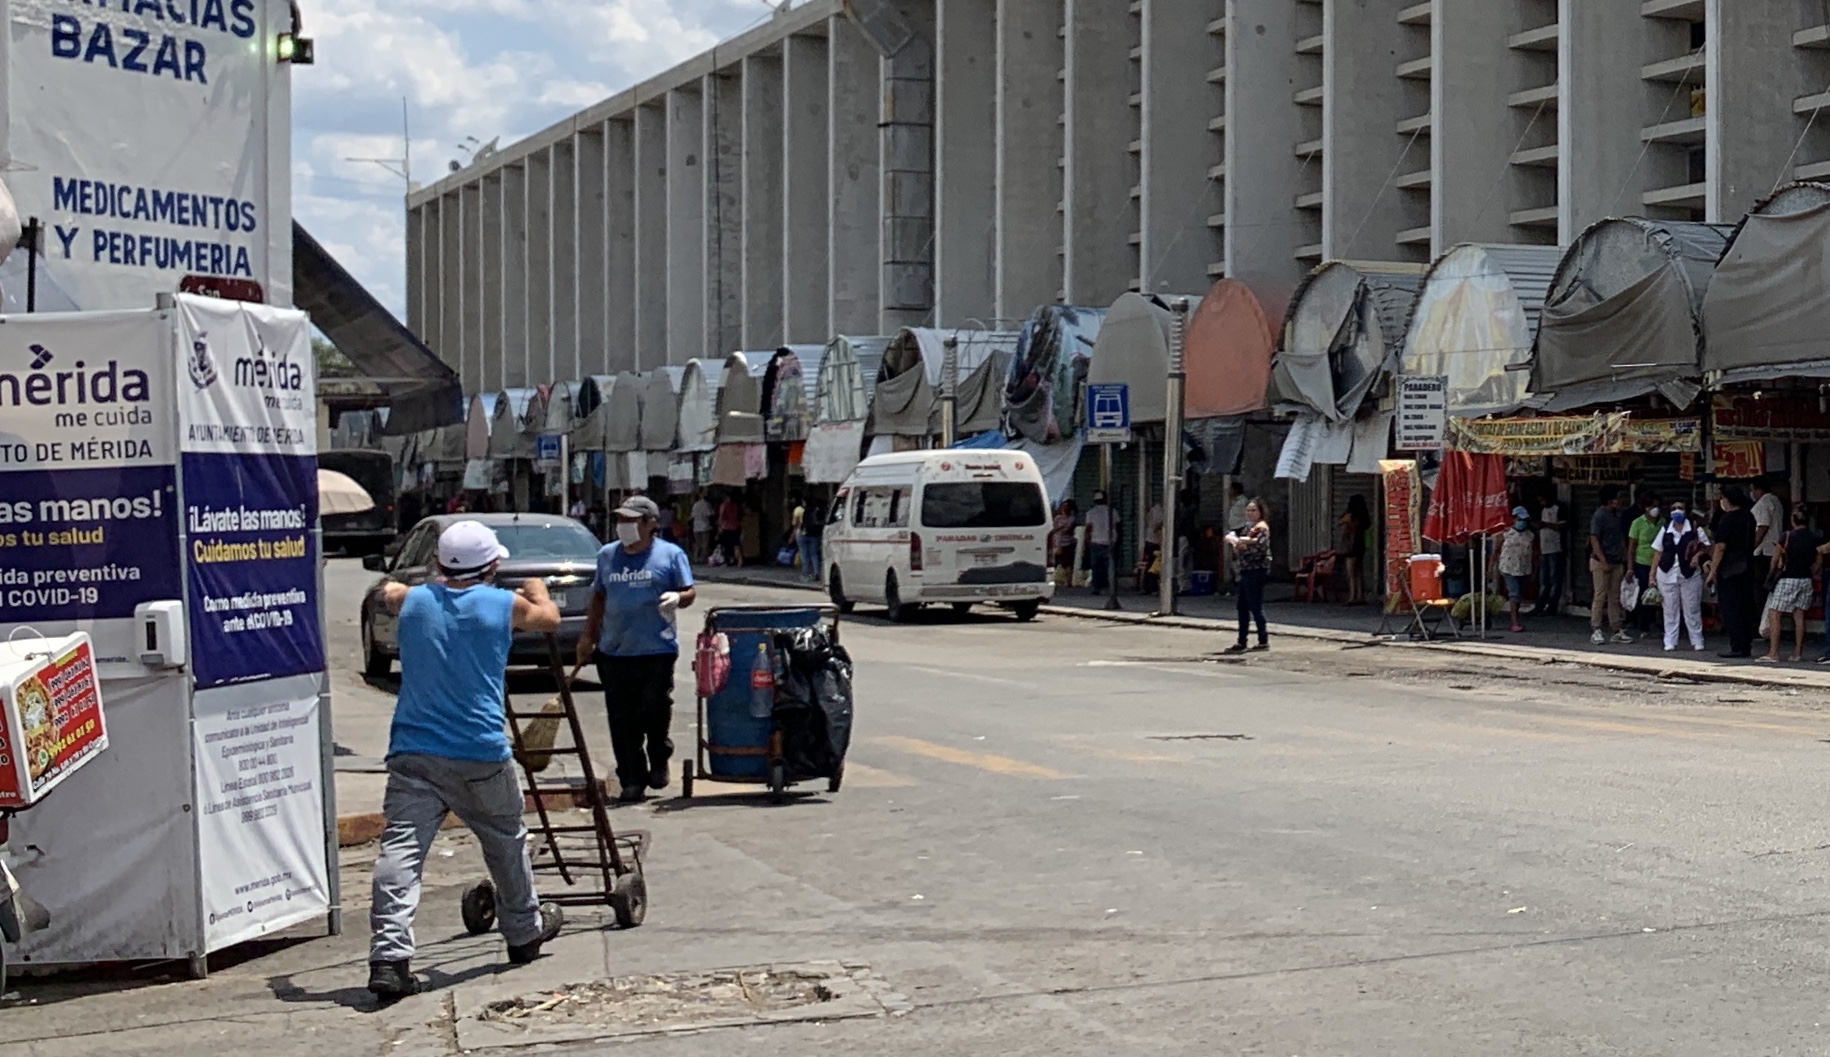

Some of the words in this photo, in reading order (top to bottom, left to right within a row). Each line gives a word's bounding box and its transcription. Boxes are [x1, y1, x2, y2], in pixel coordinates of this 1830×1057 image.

[52, 14, 207, 84] BAZAR
[53, 177, 256, 232] MEDICAMENTOS
[55, 225, 79, 259] Y
[94, 230, 251, 276] PERFUMERIA
[1404, 383, 1441, 392] PARADERO
[56, 412, 87, 427] me
[94, 406, 152, 426] cuida
[257, 425, 271, 443] DE
[36, 442, 63, 462] DE
[71, 437, 153, 460] MÉRIDA
[0, 501, 33, 524] as
[40, 489, 162, 522] manos!
[189, 505, 240, 532] ¡Lávate
[240, 505, 259, 530] las
[260, 503, 306, 530] manos!
[21, 530, 44, 546] tu
[49, 526, 104, 545] salud
[194, 538, 257, 563] Cuidamos
[258, 538, 272, 560] tu
[273, 535, 306, 558] salud
[0, 568, 29, 585] ida
[34, 564, 141, 587] preventiva
[9, 587, 99, 607] COVID-19
[203, 595, 230, 612] Como
[230, 591, 263, 610] medida
[263, 587, 307, 610] preventiva
[223, 616, 245, 633] ante
[246, 613, 255, 631] el
[254, 609, 294, 628] COVID-19
